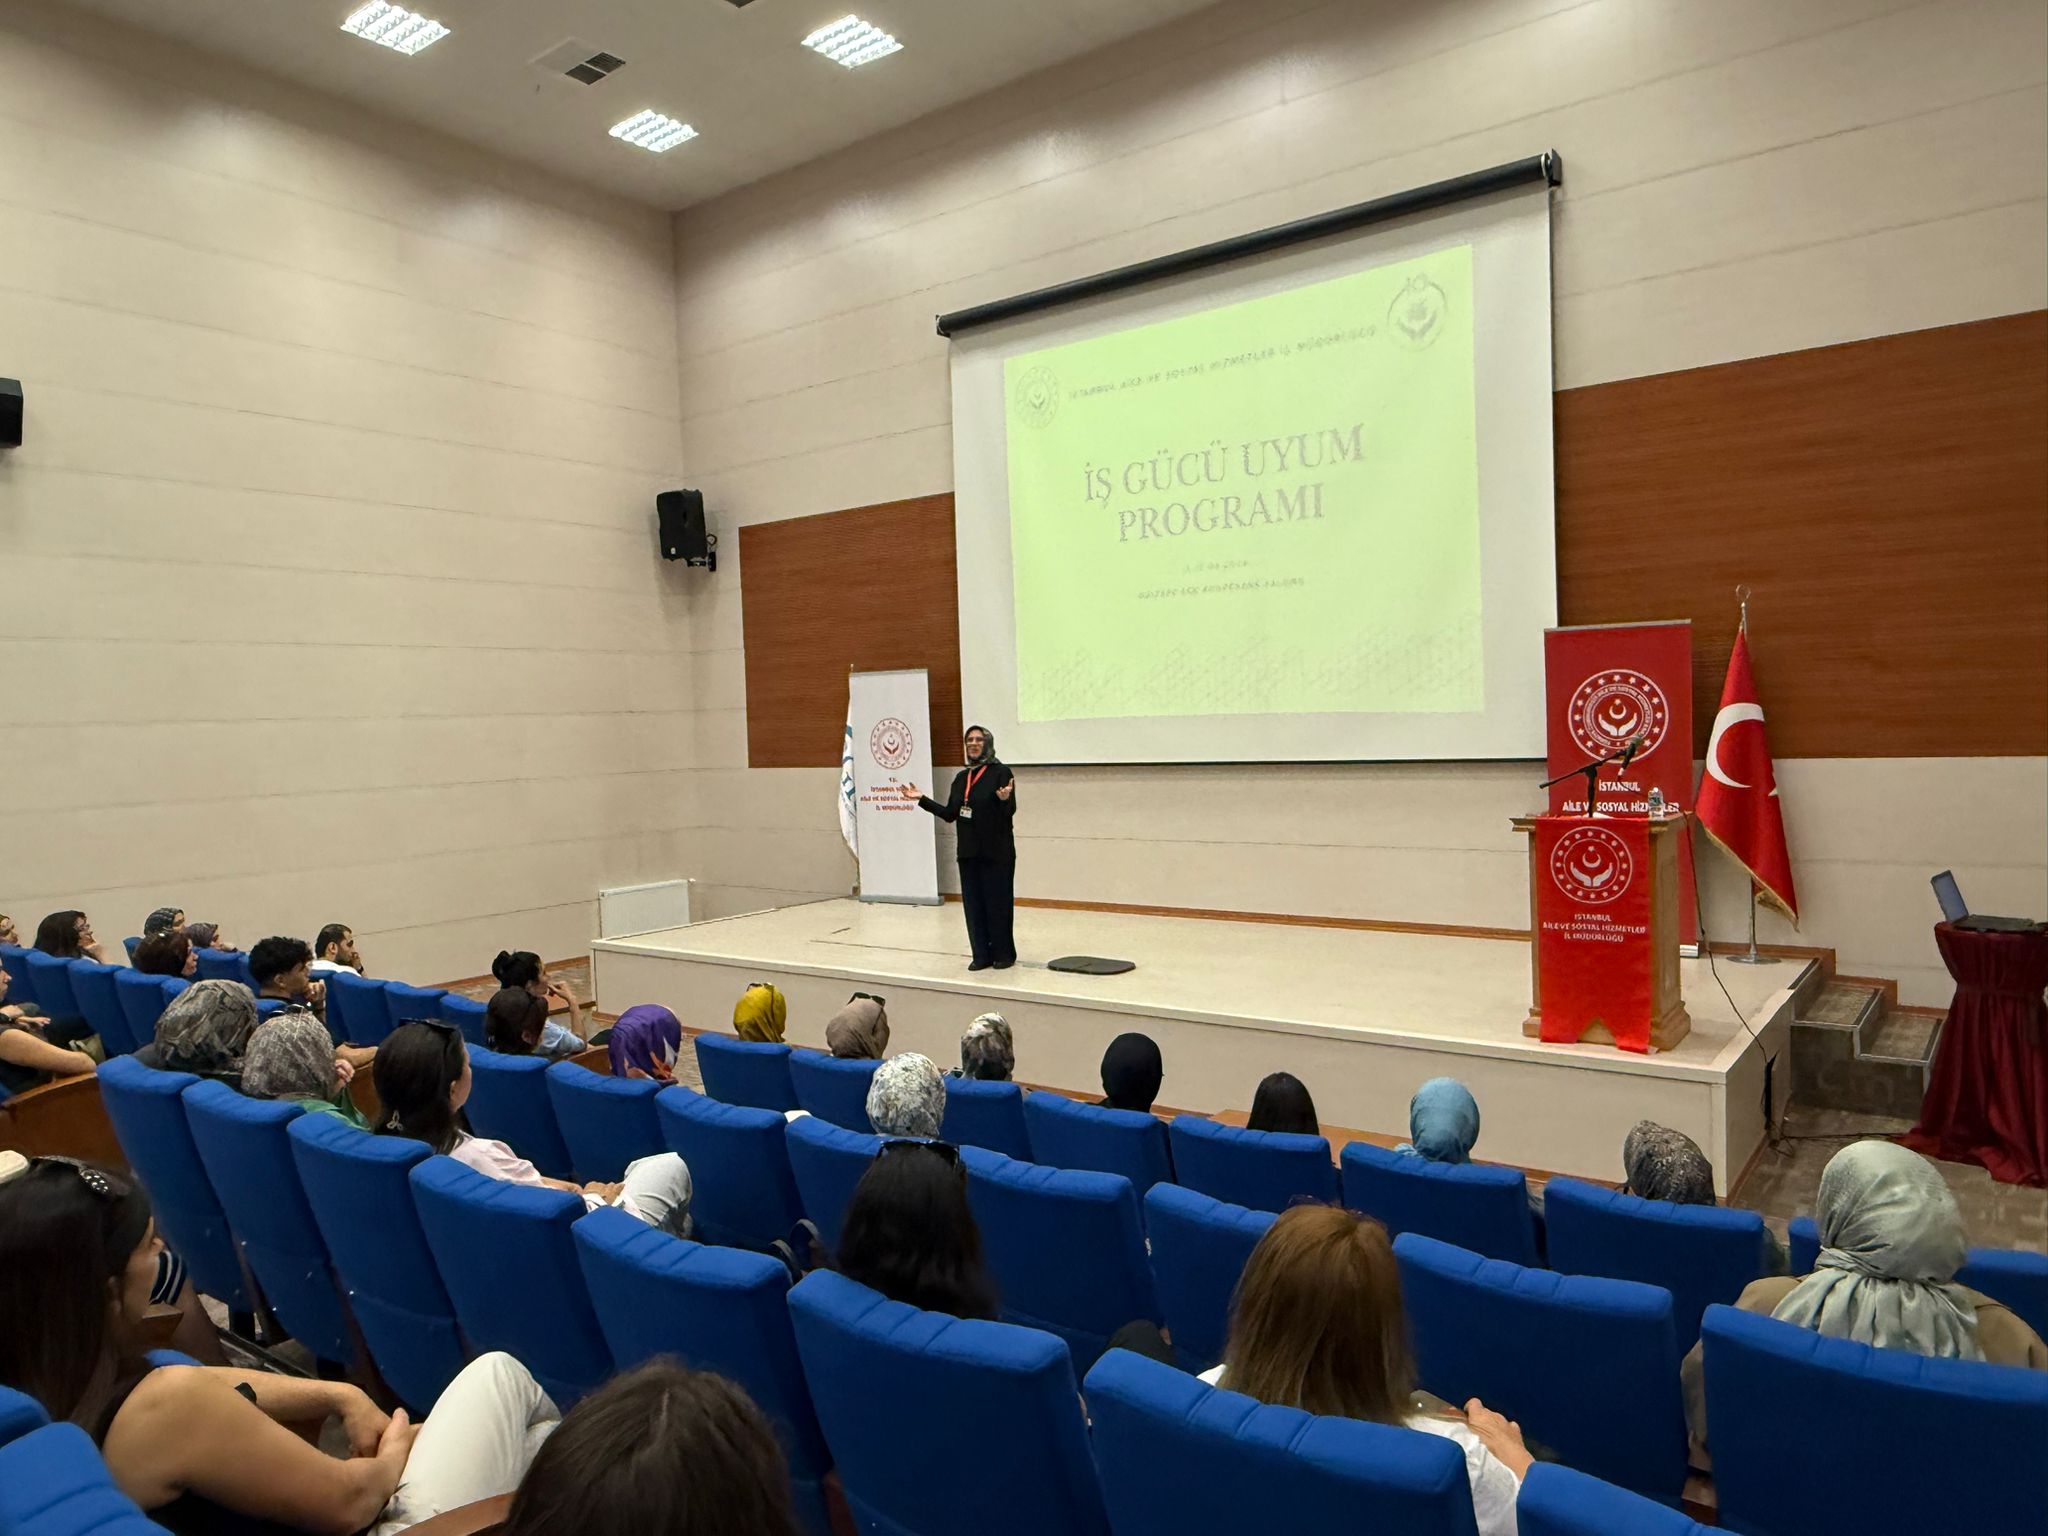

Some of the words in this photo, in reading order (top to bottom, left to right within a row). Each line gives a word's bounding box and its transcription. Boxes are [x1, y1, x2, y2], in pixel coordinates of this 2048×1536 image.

[1084, 461, 1113, 509] İŞ
[1123, 439, 1228, 495] GÜCÜ
[1240, 422, 1365, 478] UYUM
[1117, 482, 1325, 542] PROGRAMI
[1598, 779, 1641, 792] İSTANBUL
[1562, 800, 1581, 812] AİLE
[1596, 801, 1629, 812] SOSYAL
